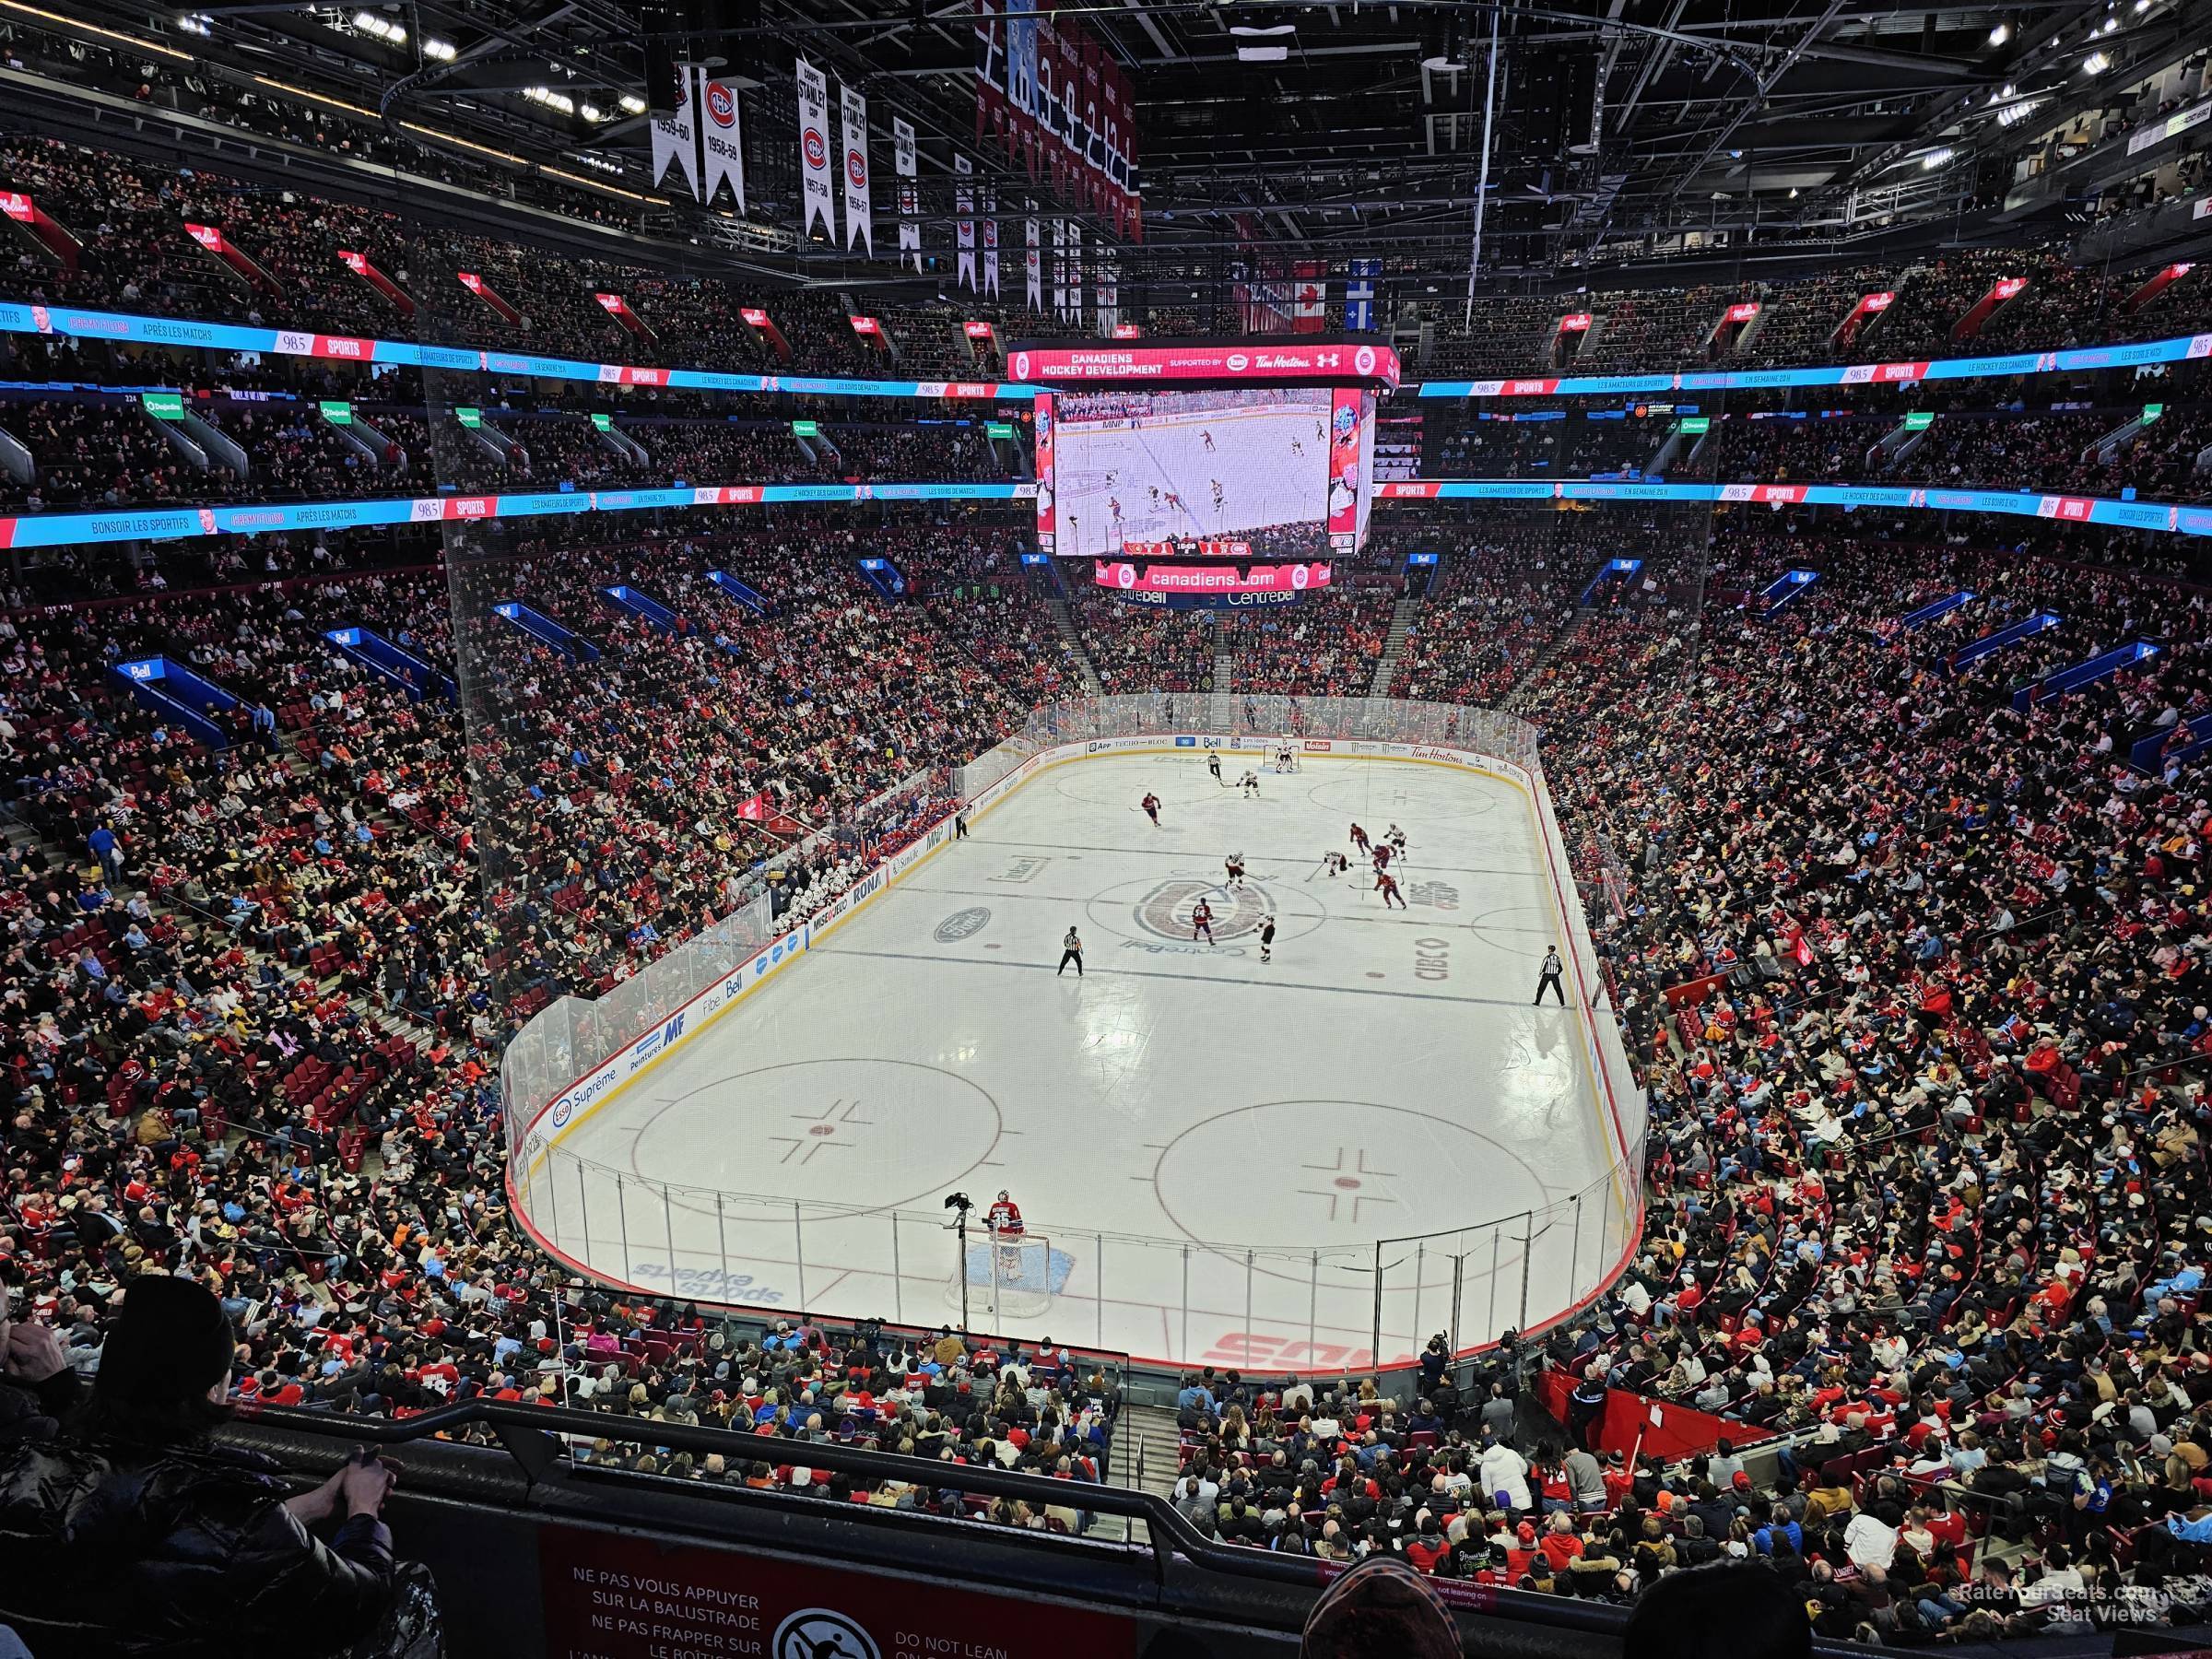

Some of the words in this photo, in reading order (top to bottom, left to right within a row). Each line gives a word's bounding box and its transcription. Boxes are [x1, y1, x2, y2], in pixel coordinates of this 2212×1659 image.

[805, 67, 819, 86] COUPE
[798, 79, 826, 111] STANLEY
[847, 93, 861, 110] COUPE
[809, 107, 818, 120] CUP
[842, 104, 866, 132] STANLEY
[656, 119, 689, 141] 1959-60
[851, 128, 860, 141] CUP
[707, 135, 737, 160] 1958-59
[894, 134, 913, 158] STANLEY
[806, 176, 828, 198] 1957-58
[0, 310, 20, 324] TIFS
[143, 323, 167, 337] APRÈS
[169, 327, 183, 337] LES
[183, 326, 213, 341] MATCHS
[327, 338, 360, 357] SPORTS
[2121, 351, 2132, 360] LES
[1071, 353, 1133, 364] CANADIENS
[1170, 359, 1212, 368] SUPPORTED
[1215, 358, 1222, 366] BY
[1254, 354, 1274, 368] Tim
[1274, 354, 1310, 369] Hortons
[1968, 364, 1976, 372] LE
[1976, 362, 1999, 371] HOCKEY
[1999, 361, 2008, 371] DES
[631, 370, 658, 382] SPORTS
[1042, 365, 1083, 376] HOCKEY
[1086, 363, 1162, 376] DEVELOPMENT
[1886, 367, 1914, 379] SPORTS
[957, 385, 985, 396] SPORTS
[1513, 382, 1543, 393] SPORTS
[1102, 419, 1124, 429] MNP
[728, 488, 753, 500] SPORTS
[1395, 486, 1426, 496] SPORTS
[1478, 487, 1488, 495] LES
[1488, 487, 1516, 495] AMATEURS
[1516, 487, 1524, 495] DE
[1624, 488, 1630, 496] EN
[1632, 488, 1655, 496] SEMAINE
[1766, 488, 1794, 500] SPORTS
[1849, 492, 1869, 500] HOCKEY
[1869, 492, 1879, 500] DES
[296, 510, 318, 523] APRÈS
[318, 510, 330, 522] LES
[330, 508, 357, 521] MATCHS
[456, 500, 486, 515] SPORTS
[2064, 500, 2085, 517] SPORTS
[91, 520, 131, 535] BONSOIR
[133, 519, 148, 532] LES
[149, 517, 190, 531] SPORTIFS
[866, 560, 877, 569] Bell
[1620, 560, 1632, 569] Bell
[1152, 571, 1275, 587] canadiens.com
[1798, 573, 1809, 582] Bell
[335, 632, 350, 644] Bell
[131, 664, 150, 680] Bell
[1204, 737, 1221, 747] Bell
[1411, 746, 1428, 759] Tim
[1429, 747, 1463, 765] Hortons
[926, 826, 943, 851] MNP
[853, 872, 882, 904] RONA
[1415, 949, 1448, 981] CIBC
[725, 972, 743, 999] Bell
[663, 1013, 686, 1047] MF
[630, 1042, 662, 1071] Peintures
[573, 1067, 617, 1107] Suprême
[633, 1263, 754, 1287] experts
[677, 1282, 784, 1303] sports
[573, 1567, 595, 1583] NE
[600, 1571, 630, 1588] PAS
[634, 1576, 680, 1596] VOUS
[685, 1585, 759, 1610] APPUYER
[1450, 1588, 1477, 1599] leaning
[593, 1591, 625, 1608] SUR
[629, 1596, 649, 1612] LA
[654, 1601, 760, 1631] BALUSTRADE
[592, 1615, 614, 1630] NE
[618, 1618, 648, 1636] PAS
[653, 1625, 724, 1649] FRAPPER
[729, 1638, 761, 1655] SUR
[650, 1643, 668, 1659] LE
[895, 1630, 920, 1647] DO
[925, 1636, 960, 1654] NOT
[965, 1643, 1007, 1659] LEAN
